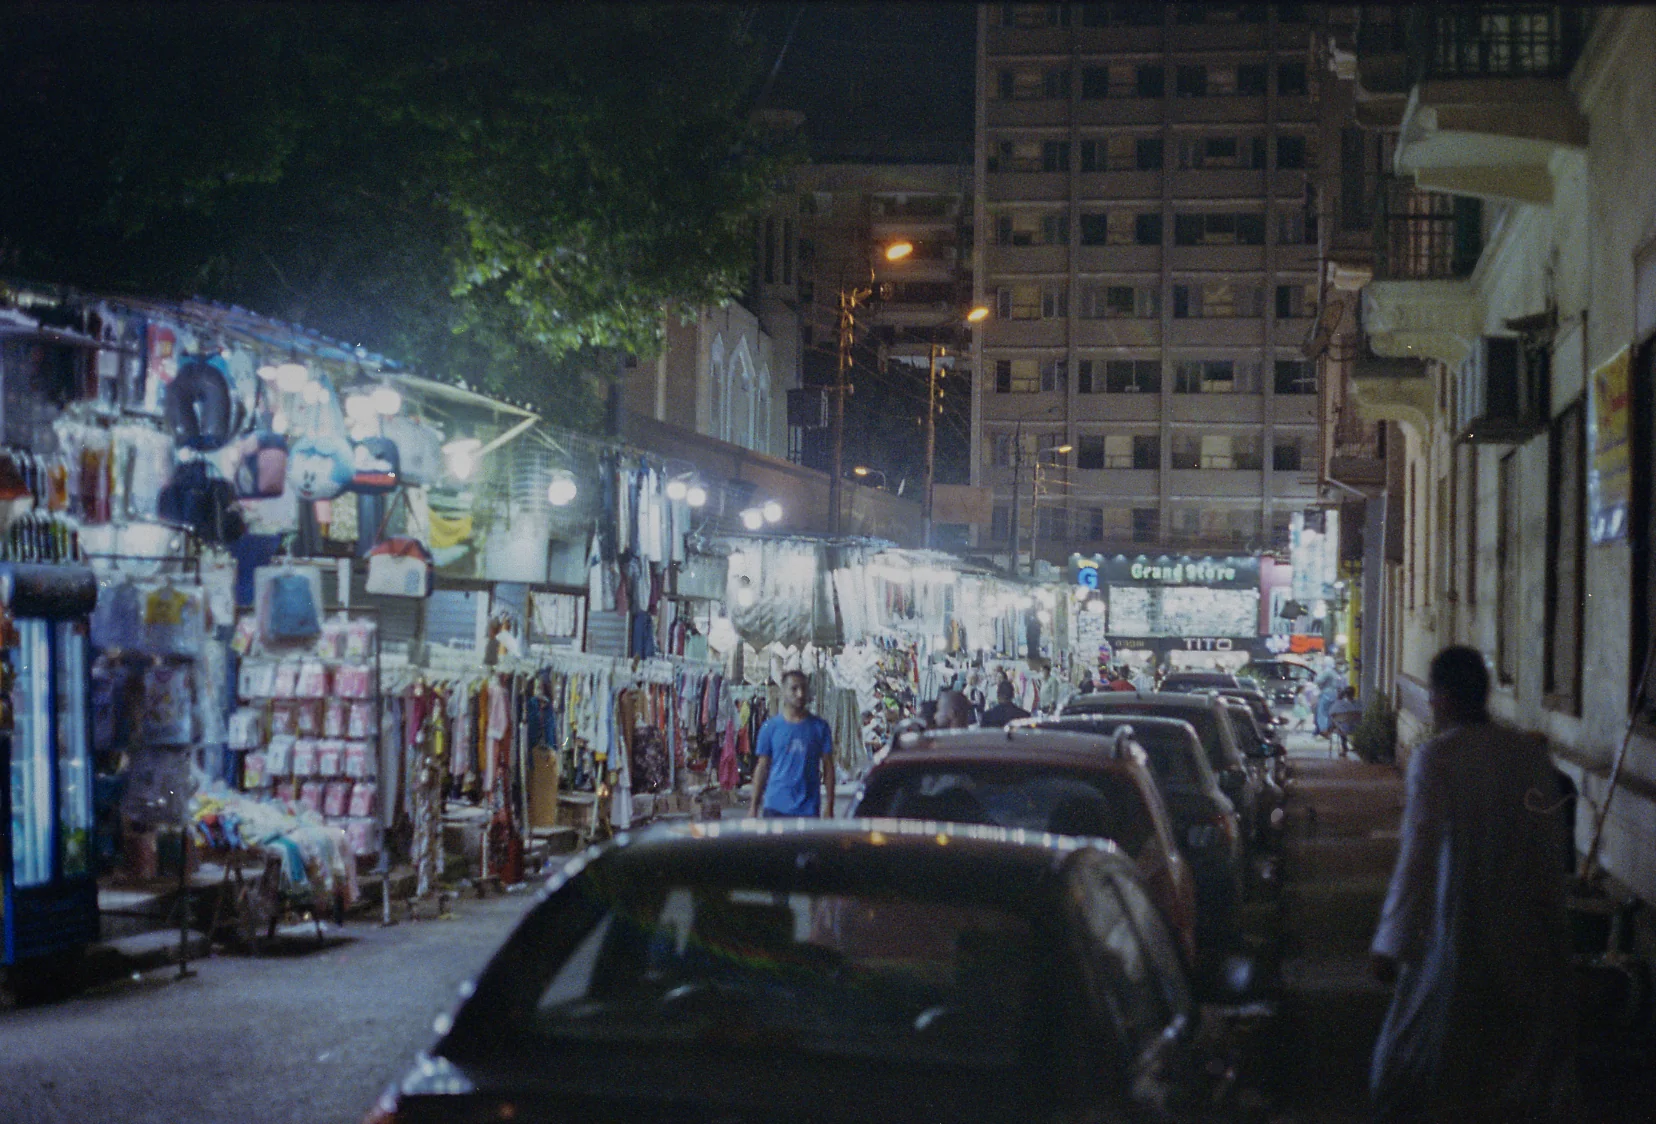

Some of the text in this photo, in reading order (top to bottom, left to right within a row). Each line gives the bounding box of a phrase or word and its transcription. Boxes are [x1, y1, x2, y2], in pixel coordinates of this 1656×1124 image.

[1078, 567, 1098, 589] G
[1131, 563, 1182, 583] Grand
[1183, 637, 1233, 651] TITO
